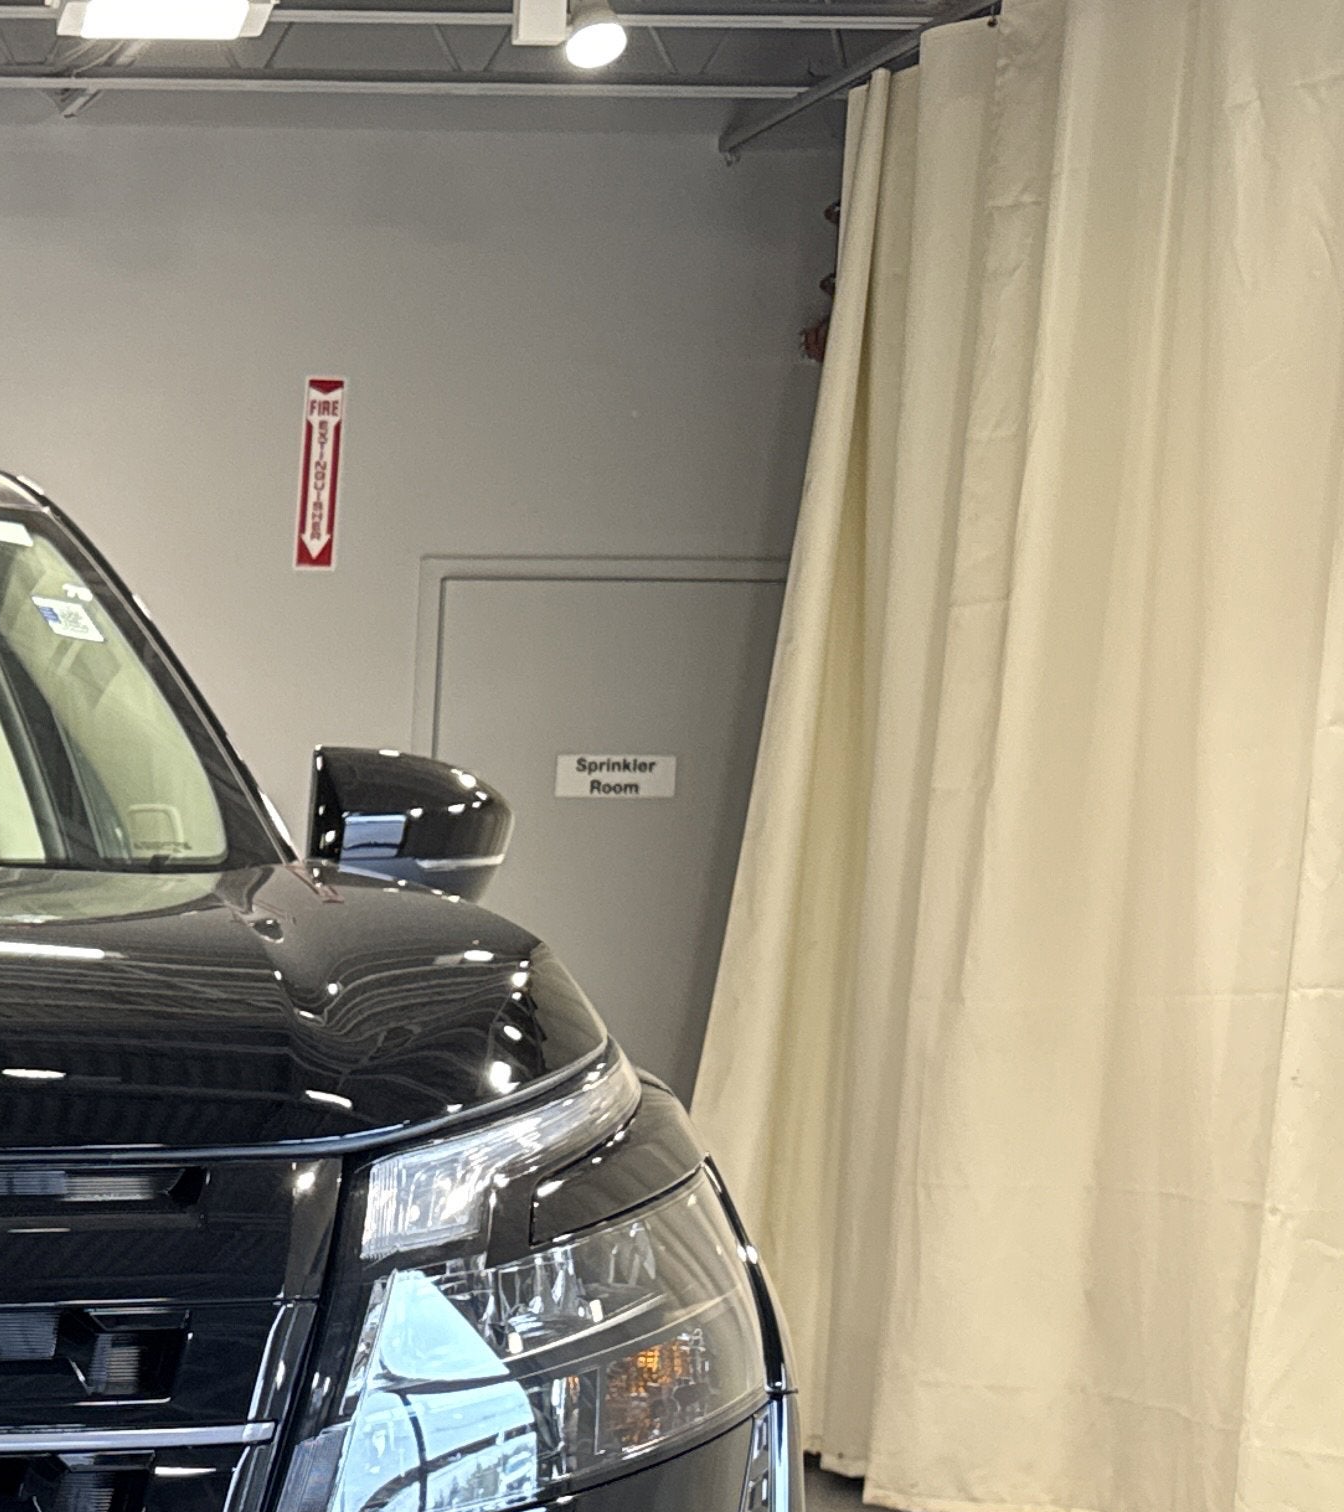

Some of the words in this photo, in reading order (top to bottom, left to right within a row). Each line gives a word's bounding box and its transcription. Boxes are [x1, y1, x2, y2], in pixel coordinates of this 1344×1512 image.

[310, 400, 339, 416] FIRE
[310, 420, 329, 541] EXTINGUISHER
[576, 758, 656, 774] Sprinkler
[590, 779, 639, 794] Room
